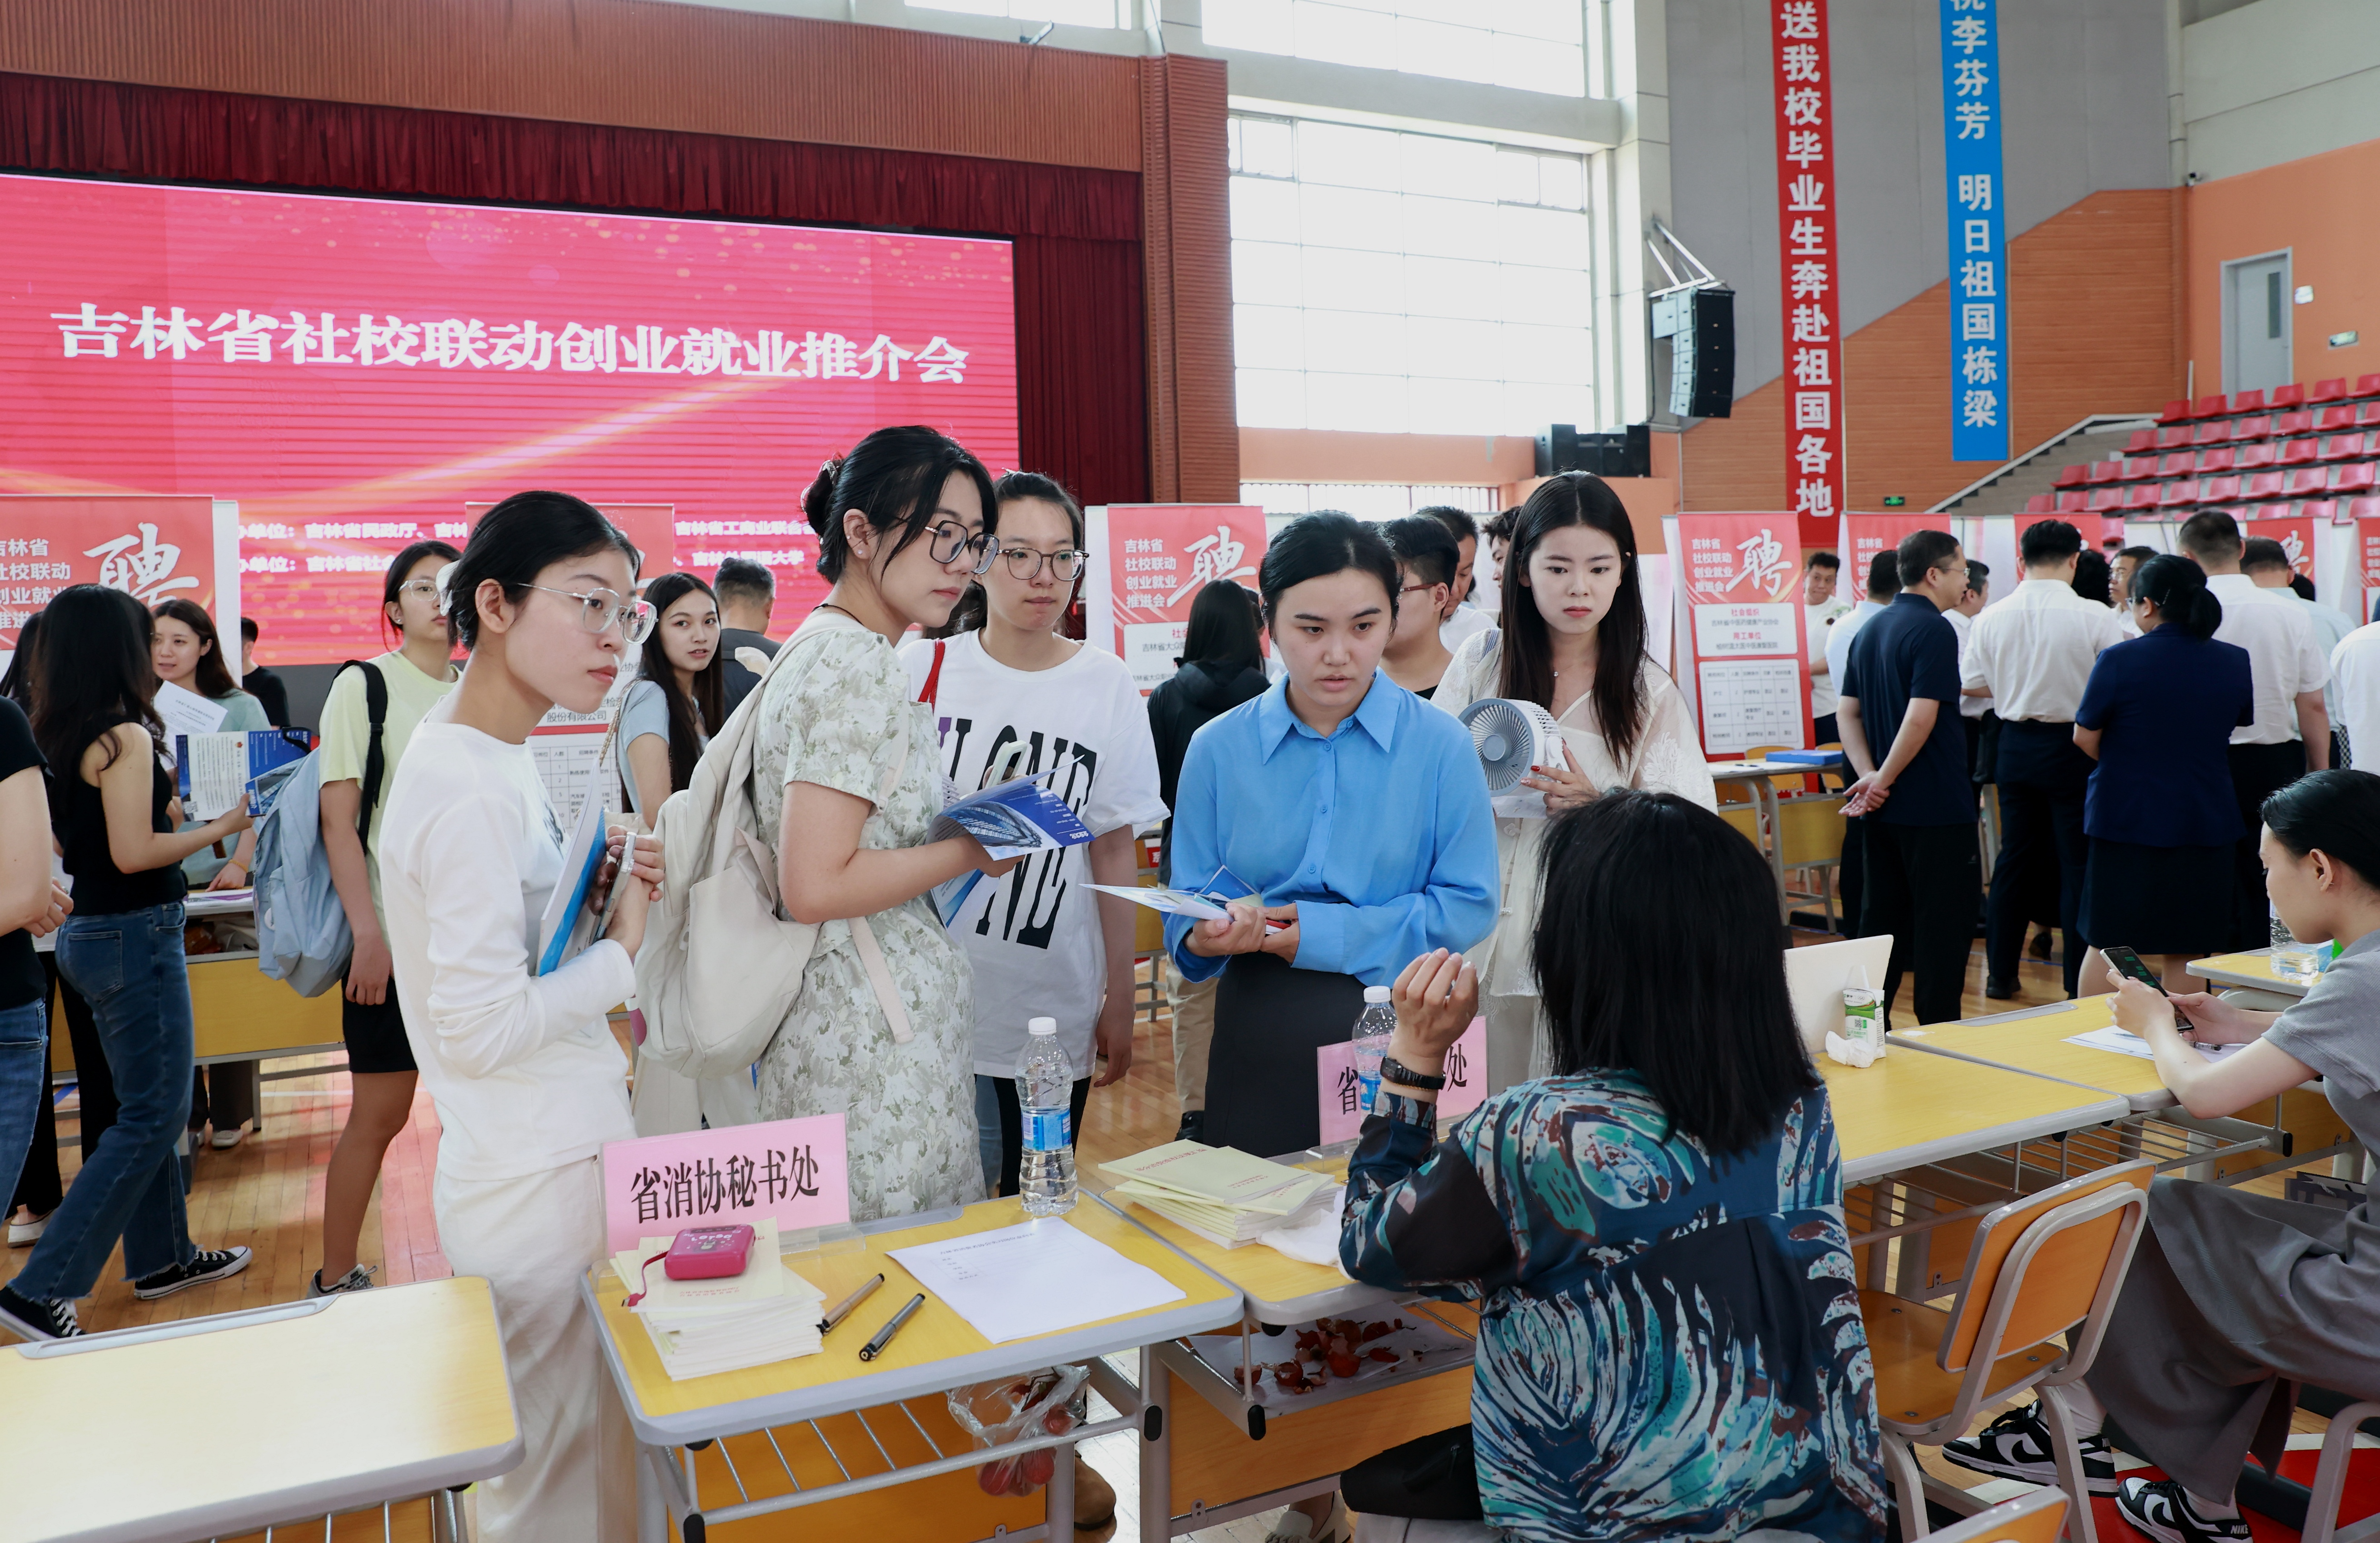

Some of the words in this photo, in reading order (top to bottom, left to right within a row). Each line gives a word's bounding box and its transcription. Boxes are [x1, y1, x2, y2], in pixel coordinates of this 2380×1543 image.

[1780, 1, 1834, 517] 送我校毕业生奔赴祖国各地
[1958, 174, 1997, 428] 明日祖国栋梁
[50, 303, 970, 383] 吉林省社校联动创业就业推介会
[1124, 538, 1164, 553] 吉林省
[1691, 538, 1721, 550] 吉林省
[83, 522, 199, 607] 聘
[1125, 556, 1176, 572] 社校联动
[1167, 525, 1257, 607] 聘
[1693, 552, 1733, 564] 社校联动
[1726, 528, 1792, 597] 聘
[1694, 566, 1734, 578] 创业就业
[1125, 575, 1178, 590] 创业就业
[1126, 593, 1165, 609] 推进会
[1733, 632, 1762, 640] 用工单位
[547, 710, 606, 722] 股份有限公司
[631, 1144, 820, 1224] 省消协秘书处
[2230, 1524, 2249, 1534] NIKE
